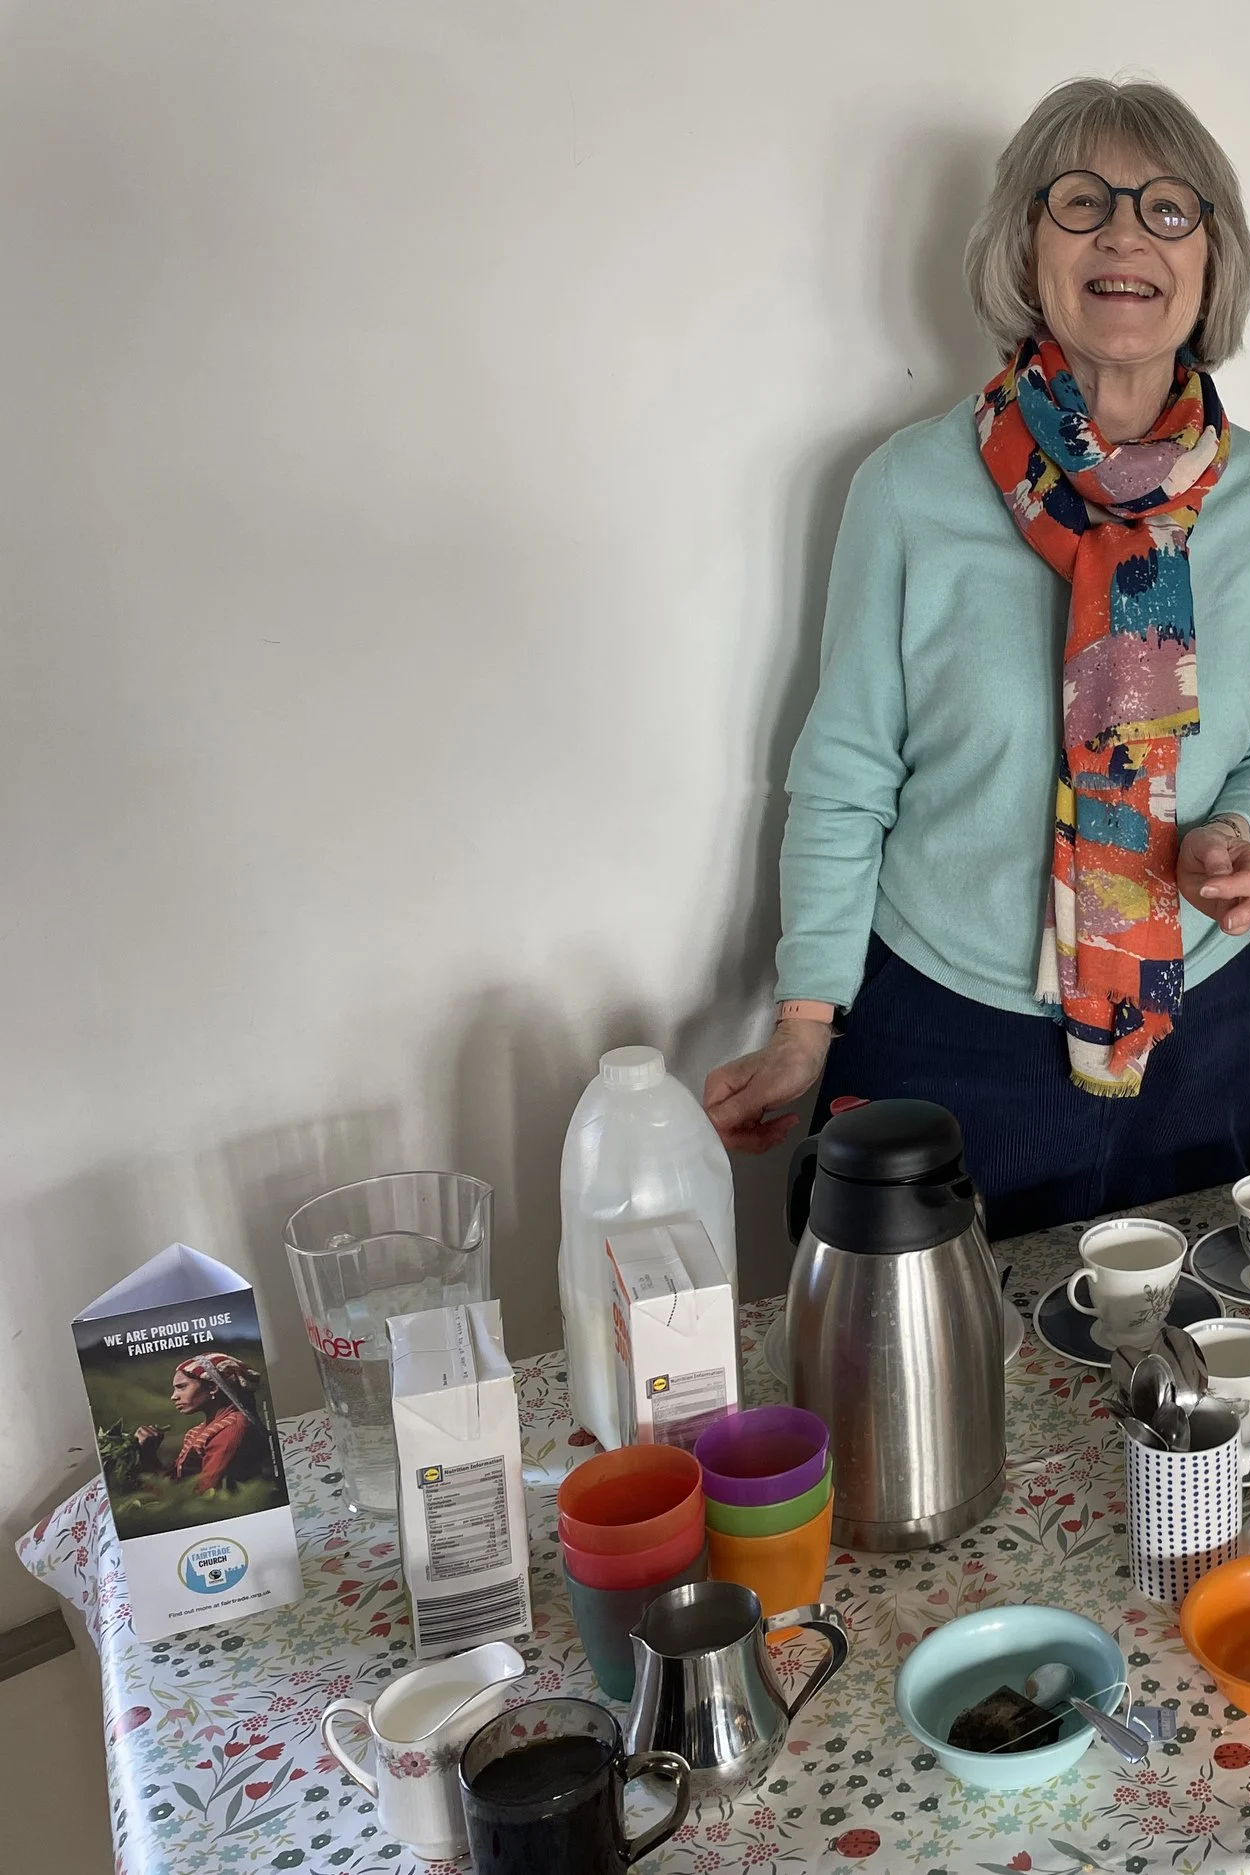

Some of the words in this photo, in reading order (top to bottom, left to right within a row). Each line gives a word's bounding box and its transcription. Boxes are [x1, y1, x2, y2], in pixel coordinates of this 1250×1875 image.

[104, 1334, 123, 1346] WE
[126, 1330, 148, 1343] ARE
[150, 1322, 190, 1338] PROUD
[192, 1318, 206, 1330] TO
[210, 1312, 232, 1326] USE
[128, 1335, 190, 1356] FAIRTRADE
[192, 1330, 214, 1344] TEA
[444, 1466, 469, 1475] Nutrition
[470, 1458, 502, 1469] Information
[192, 1546, 231, 1561] FAIRTRADE
[198, 1555, 227, 1567] CHURCH
[221, 1590, 271, 1606] fairtrade.org.uk
